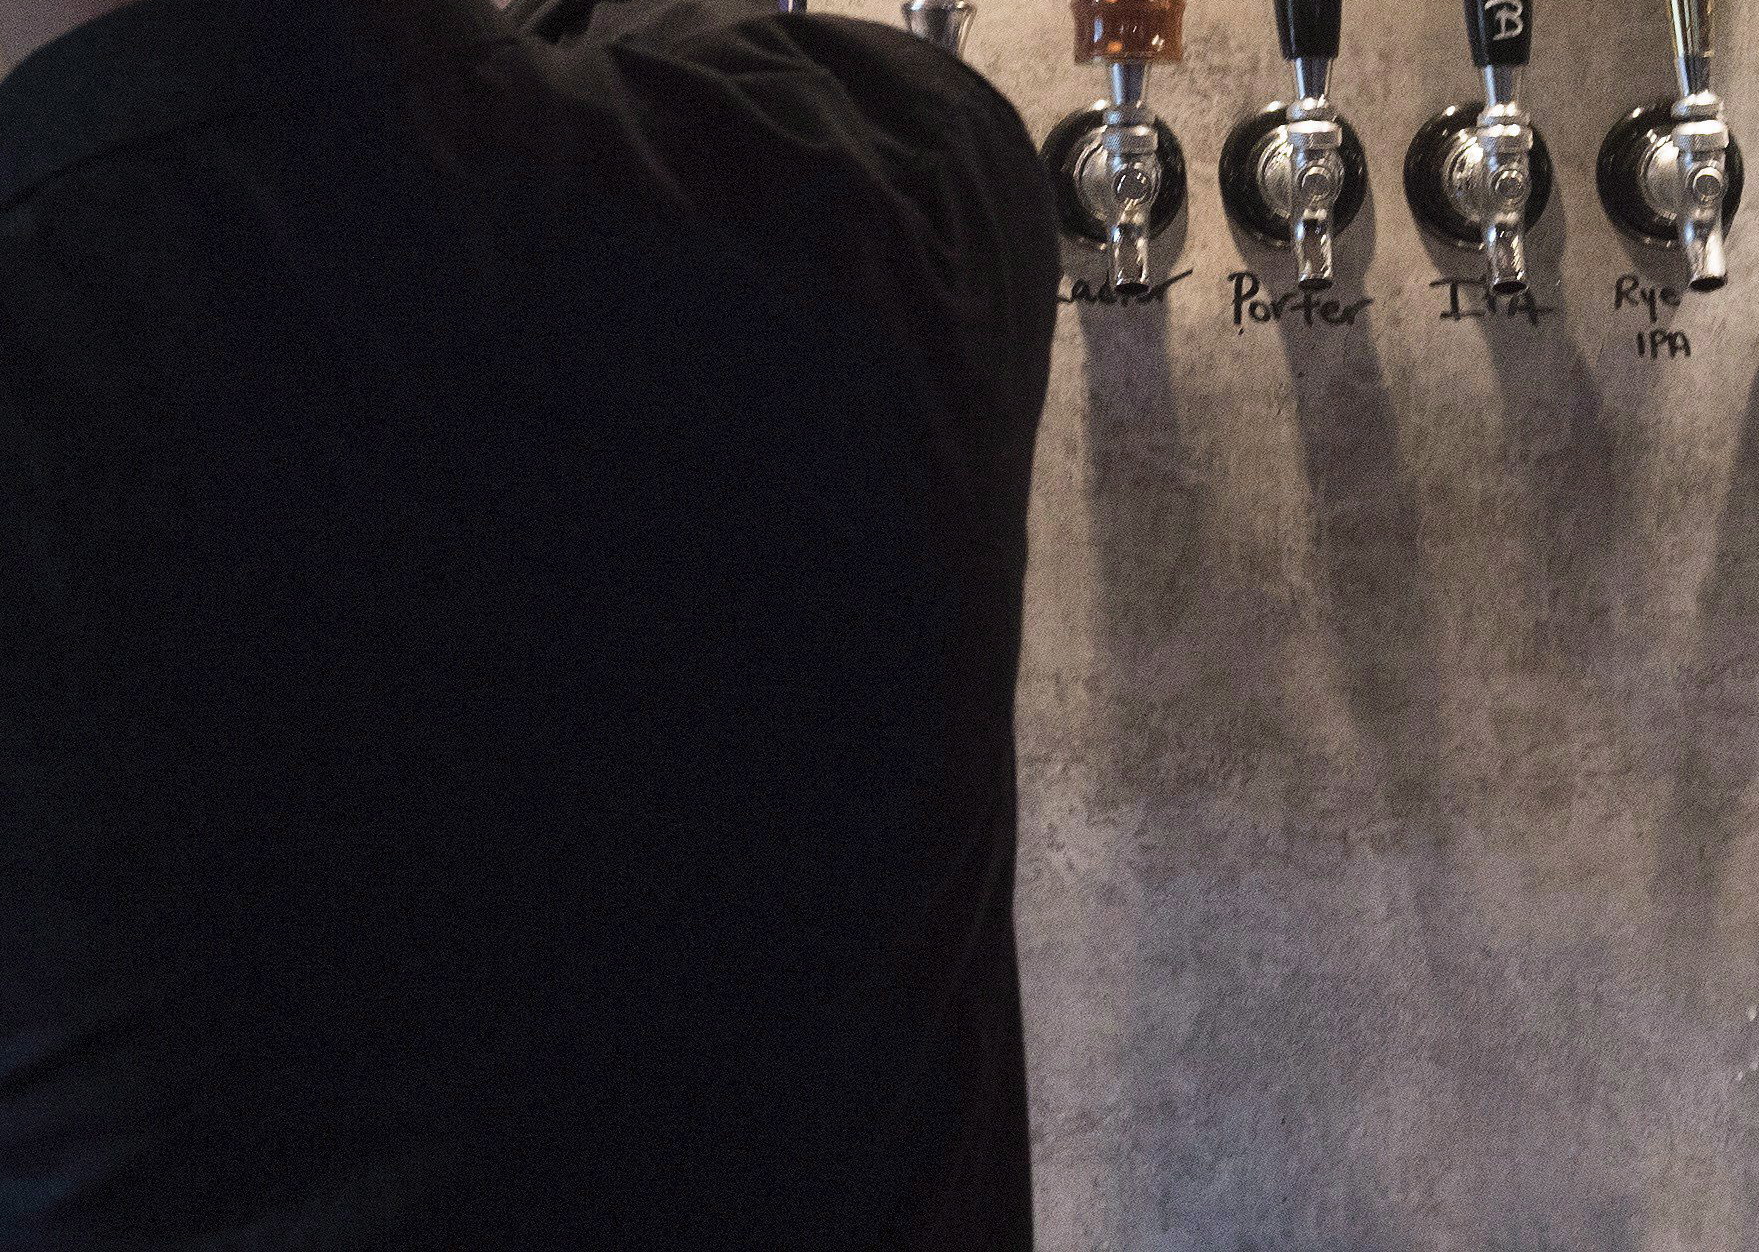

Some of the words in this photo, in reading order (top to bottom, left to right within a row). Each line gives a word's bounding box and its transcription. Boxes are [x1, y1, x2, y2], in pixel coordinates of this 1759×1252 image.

[1227, 271, 1373, 327] Porter
[1614, 273, 1681, 322] Rye
[1636, 327, 1691, 359] IPA
